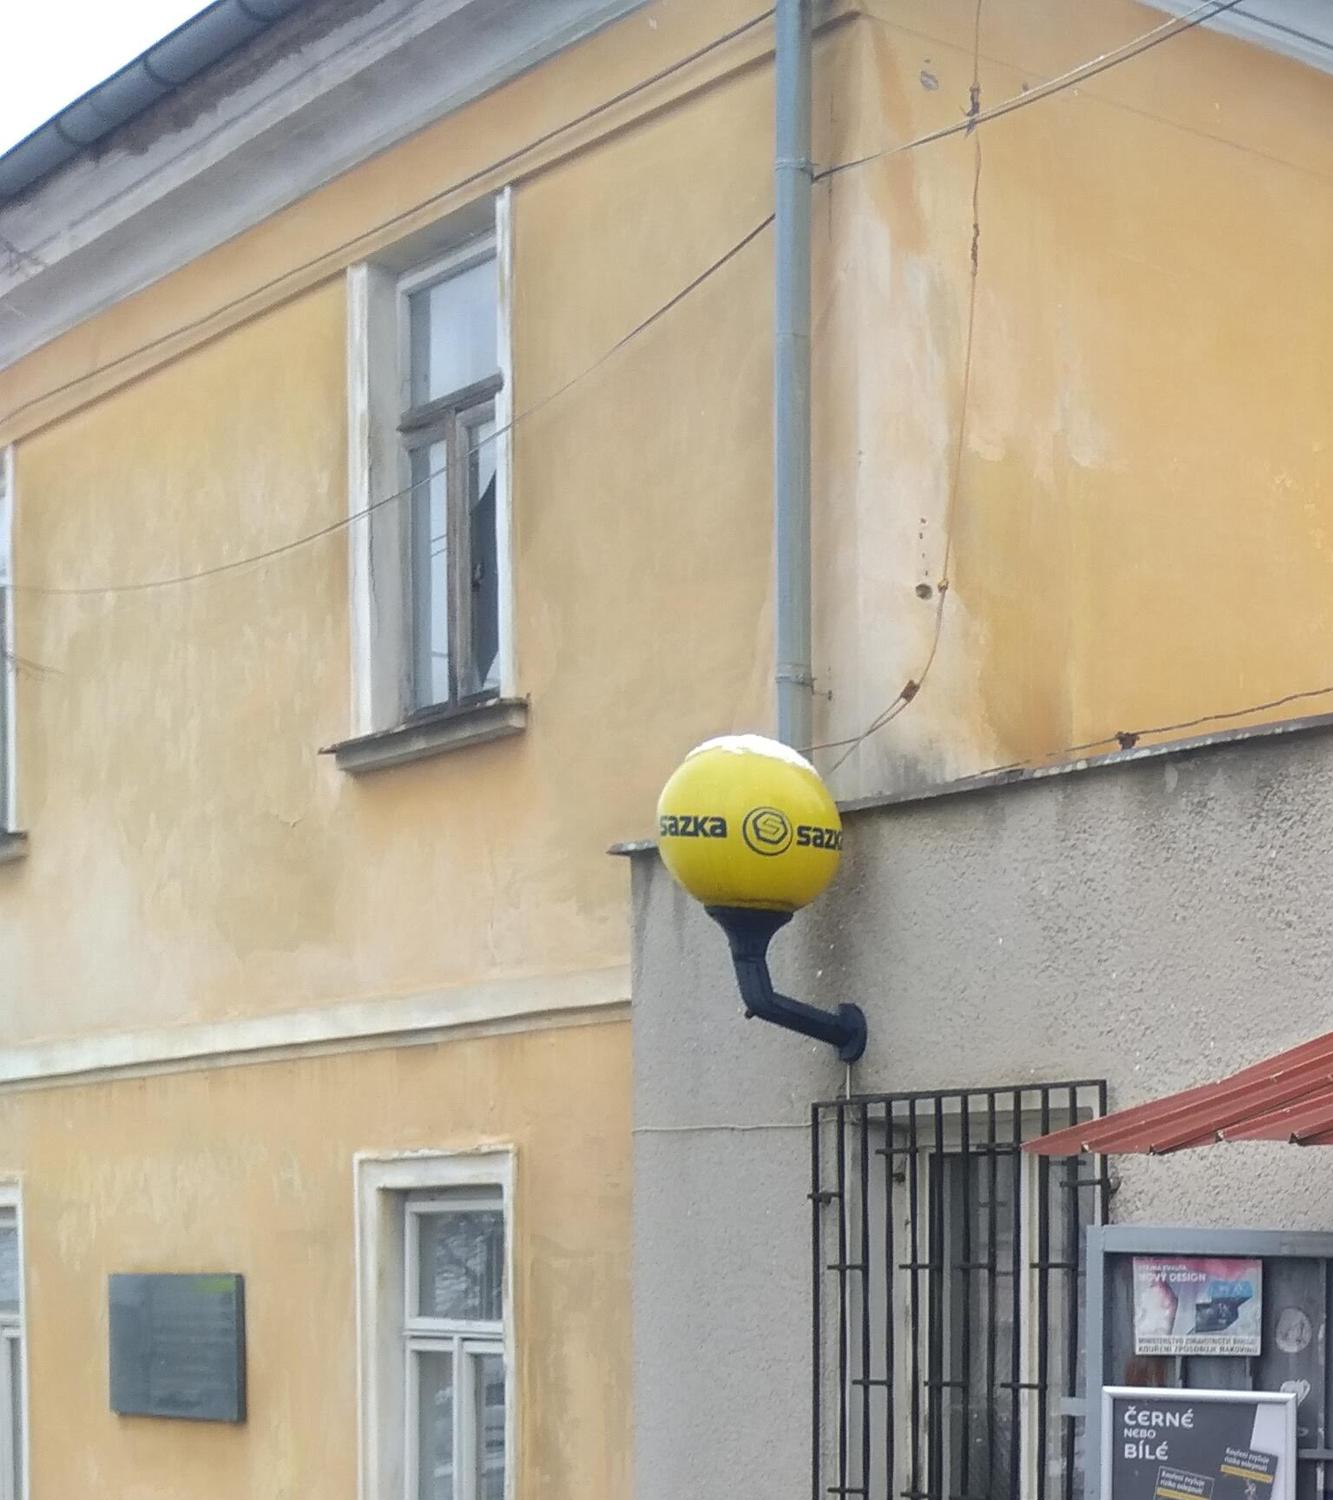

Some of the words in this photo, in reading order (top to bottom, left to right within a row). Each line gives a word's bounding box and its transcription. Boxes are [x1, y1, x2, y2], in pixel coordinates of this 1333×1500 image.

[660, 815, 727, 838] sazka
[1169, 1272, 1206, 1282] DESIGN
[1124, 1406, 1194, 1428] ČERNÉ
[1124, 1428, 1156, 1439] NEBO
[1124, 1441, 1169, 1461] BÍLÉ
